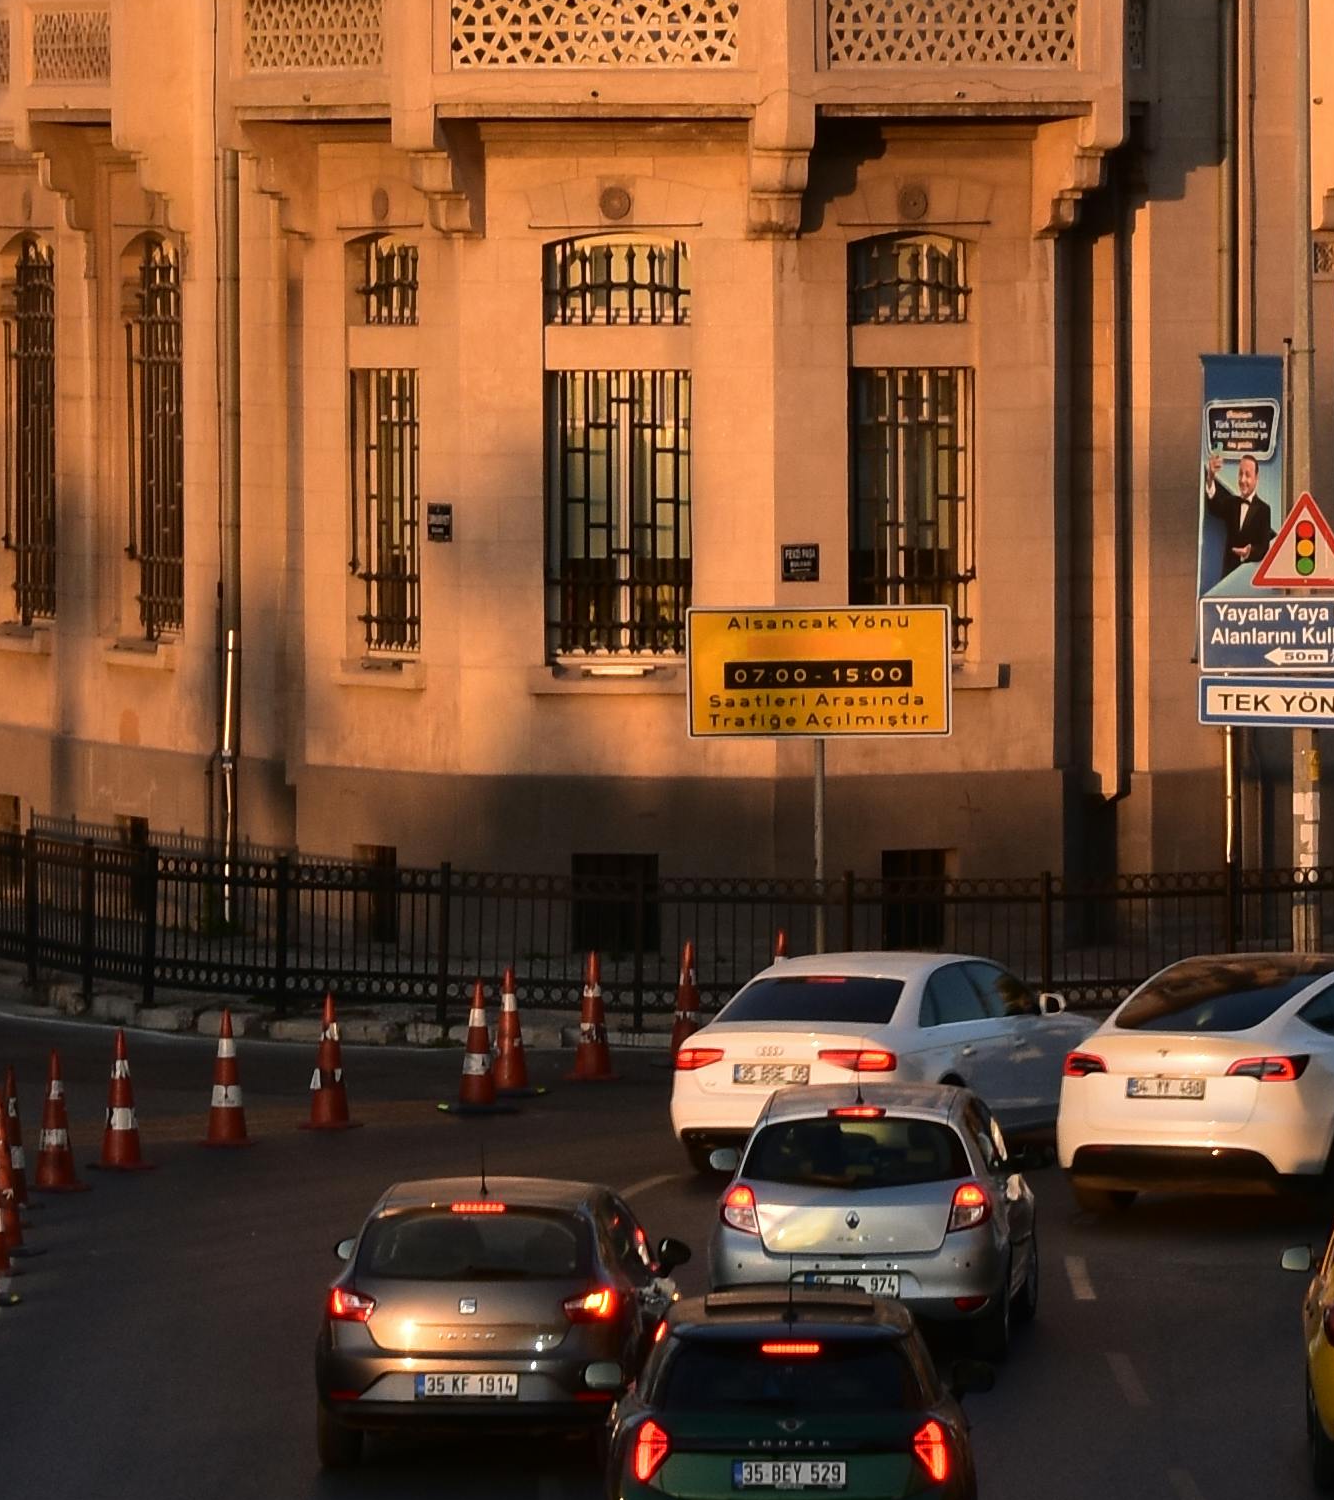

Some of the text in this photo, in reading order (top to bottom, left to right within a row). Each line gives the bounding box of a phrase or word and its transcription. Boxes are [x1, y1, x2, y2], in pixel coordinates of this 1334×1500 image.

[727, 616, 838, 630] Alsancak
[1216, 604, 1282, 625] Yayalar
[1286, 604, 1329, 625] Yaya
[1211, 627, 1296, 645] Alanlarını
[1284, 652, 1324, 661] 50m
[734, 668, 807, 683] 07:00
[832, 667, 903, 682] 15:00
[709, 693, 924, 708] Saatleri Arasında
[1218, 693, 1271, 712] TEK
[709, 712, 929, 729] Trafiğe Açılmıştır
[870, 1276, 896, 1291] 974
[427, 1375, 513, 1393] 35 KF 1914
[744, 1463, 841, 1484] 35 BEY 529
